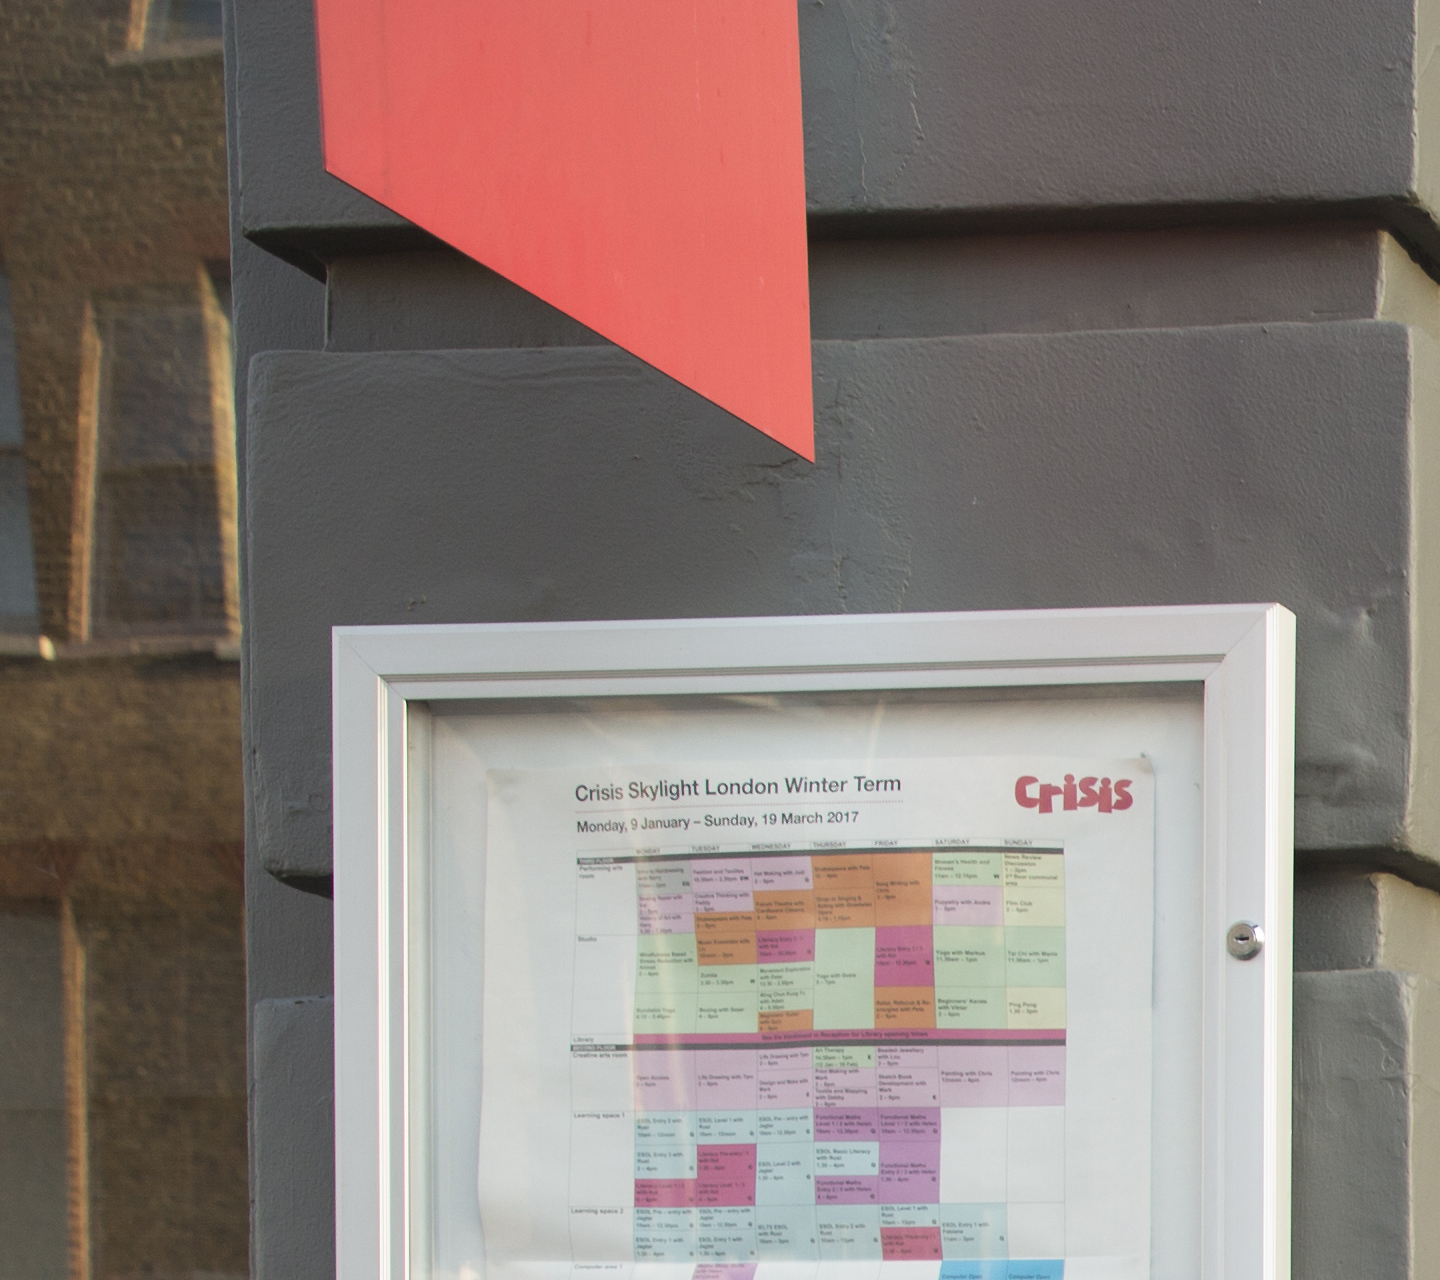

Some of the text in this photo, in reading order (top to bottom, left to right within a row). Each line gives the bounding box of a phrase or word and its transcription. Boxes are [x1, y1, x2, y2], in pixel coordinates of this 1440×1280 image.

[576, 776, 900, 801] Crisis Skylight London Winter Term
[577, 821, 627, 833] Monday,
[631, 819, 638, 830] 9
[641, 818, 690, 830] January
[705, 815, 757, 827] Sunday,
[762, 813, 777, 825] 19
[782, 813, 822, 824] March
[827, 812, 858, 823] 2017
